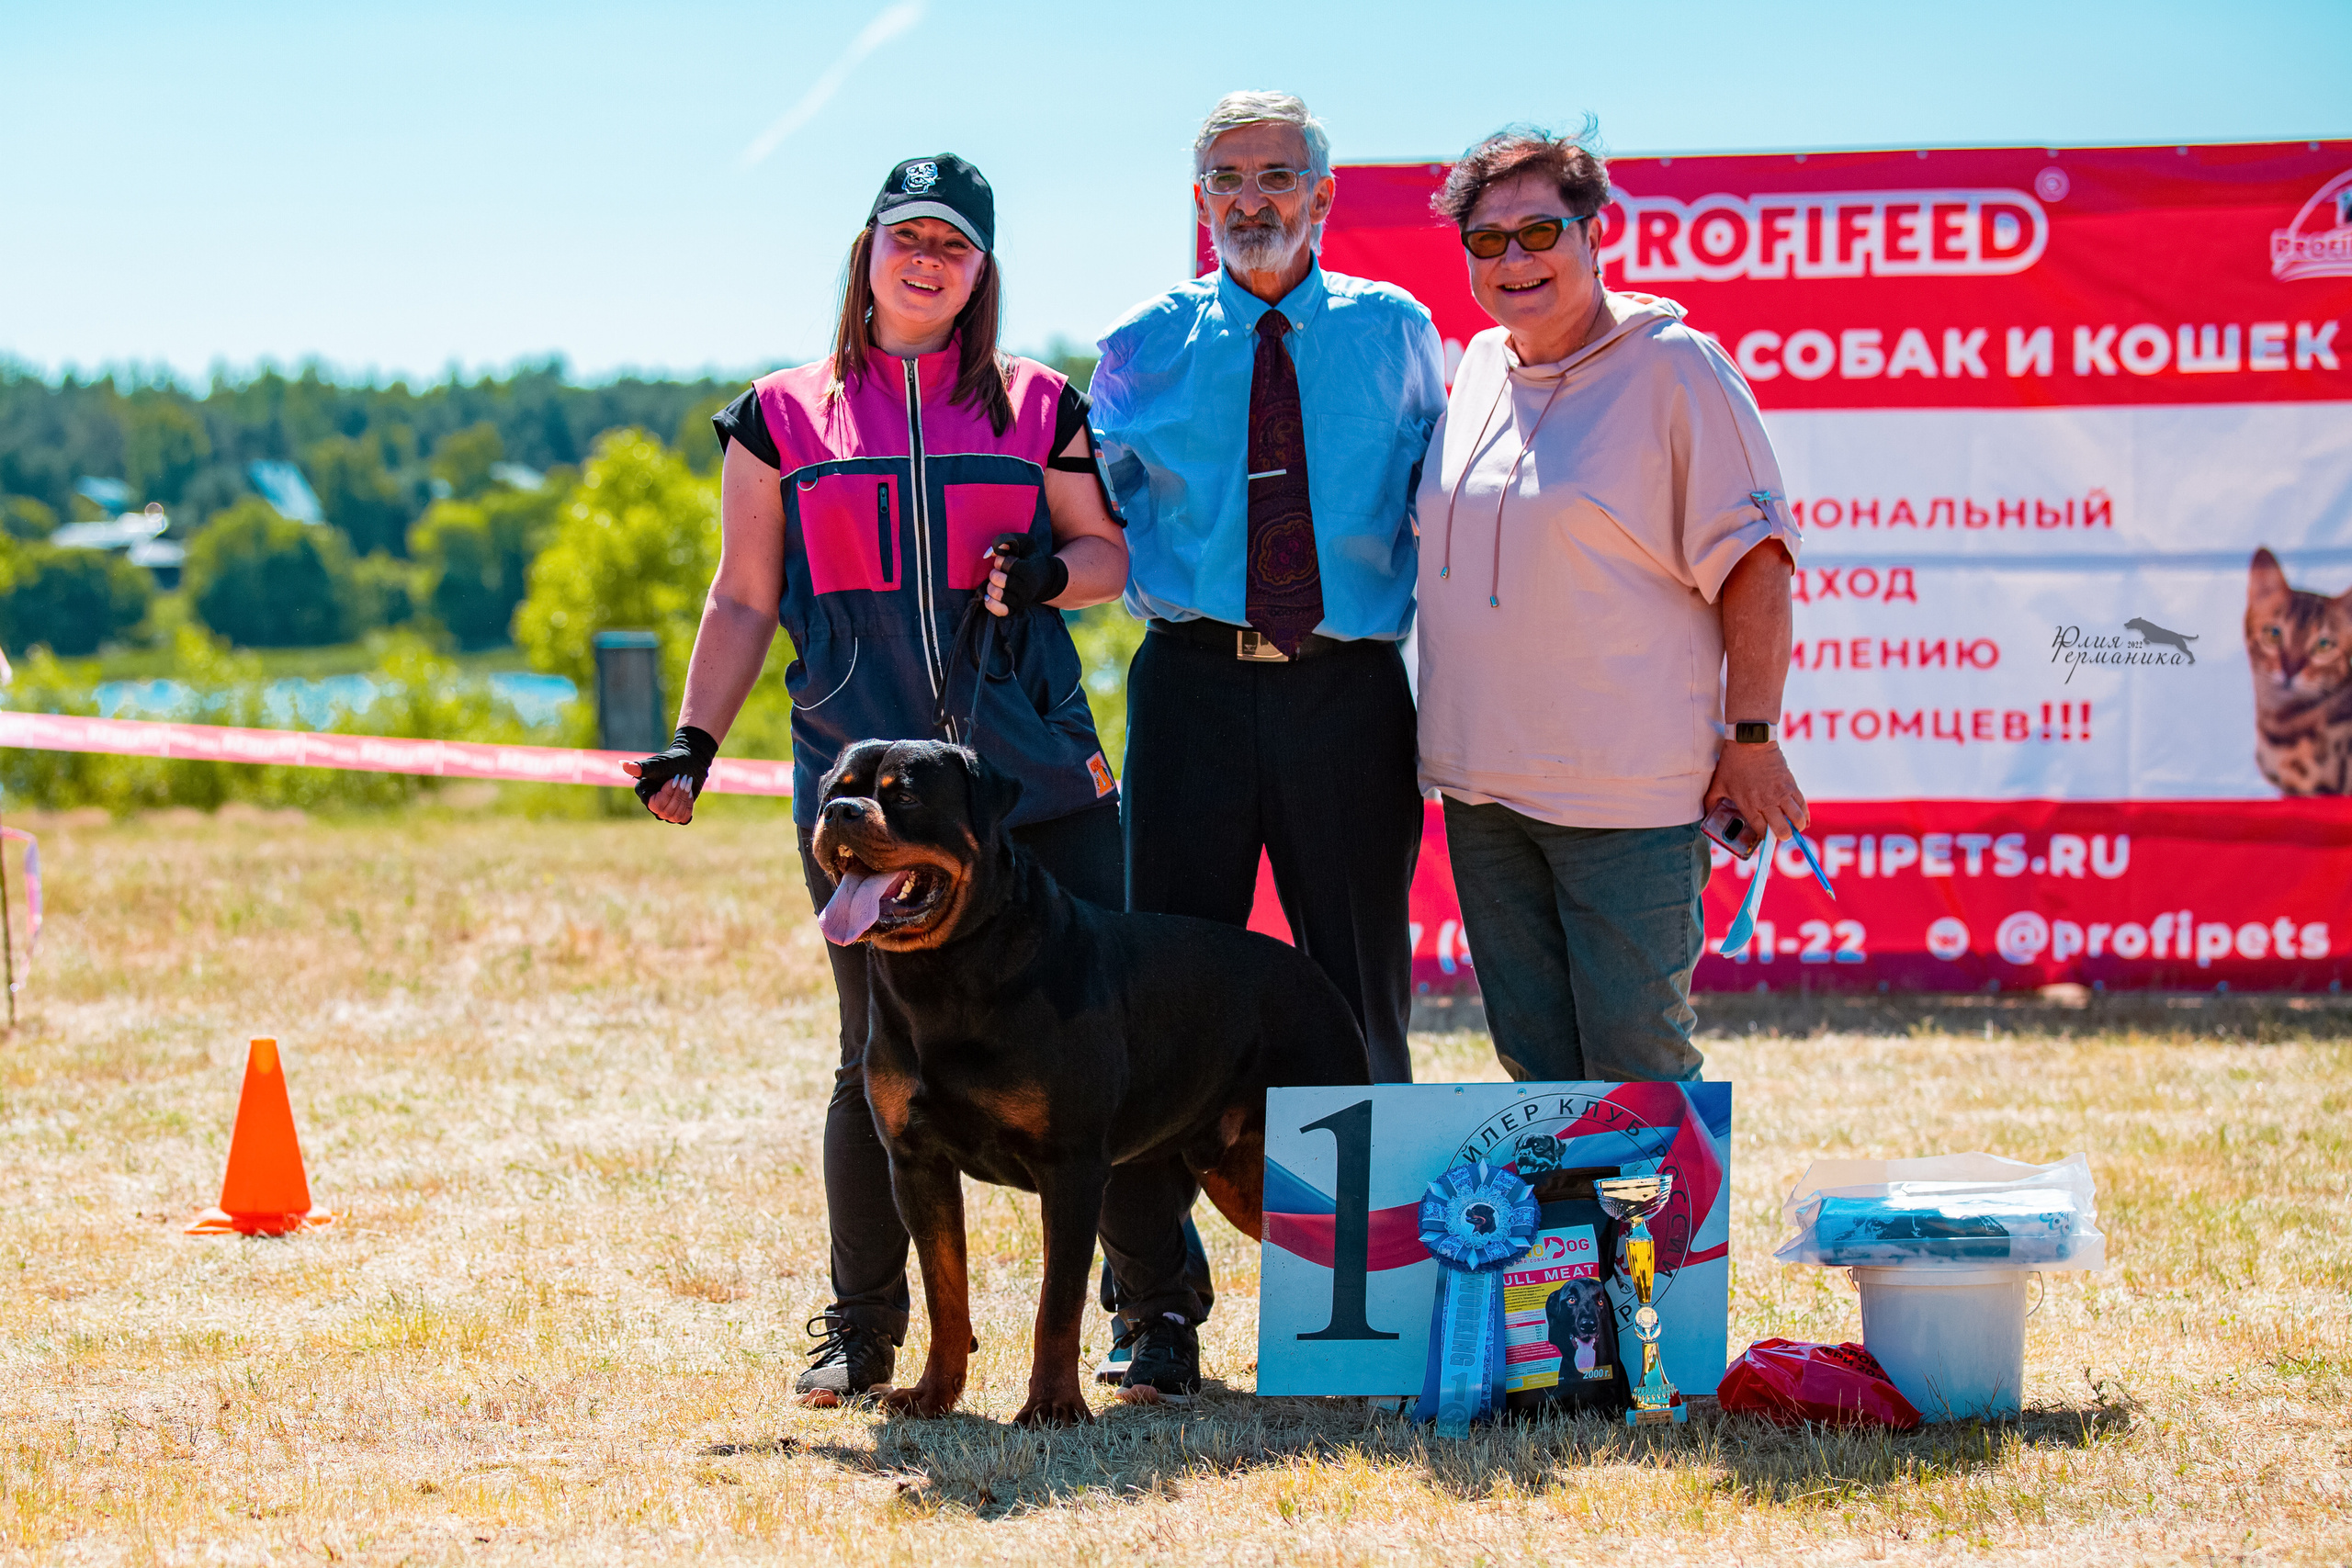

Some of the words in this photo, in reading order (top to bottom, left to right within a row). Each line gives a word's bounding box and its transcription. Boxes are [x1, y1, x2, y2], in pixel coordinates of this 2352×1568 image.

[1599, 190, 2045, 279] PROFIFEED
[1736, 327, 1989, 381] СОБАК
[2006, 326, 2053, 377] И
[2074, 321, 2340, 376] КОШЕК
[1996, 909, 2332, 968] @profipets
[1559, 1099, 1644, 1136] КЛУБ
[1649, 1144, 1688, 1278] РОССИИ
[1296, 1100, 1399, 1340] 1
[1544, 1264, 1594, 1281] MEAT
[1450, 1273, 1485, 1367] WORKING
[1582, 1369, 1604, 1380] 2000
[1819, 1347, 1854, 1367] ЕРИ
